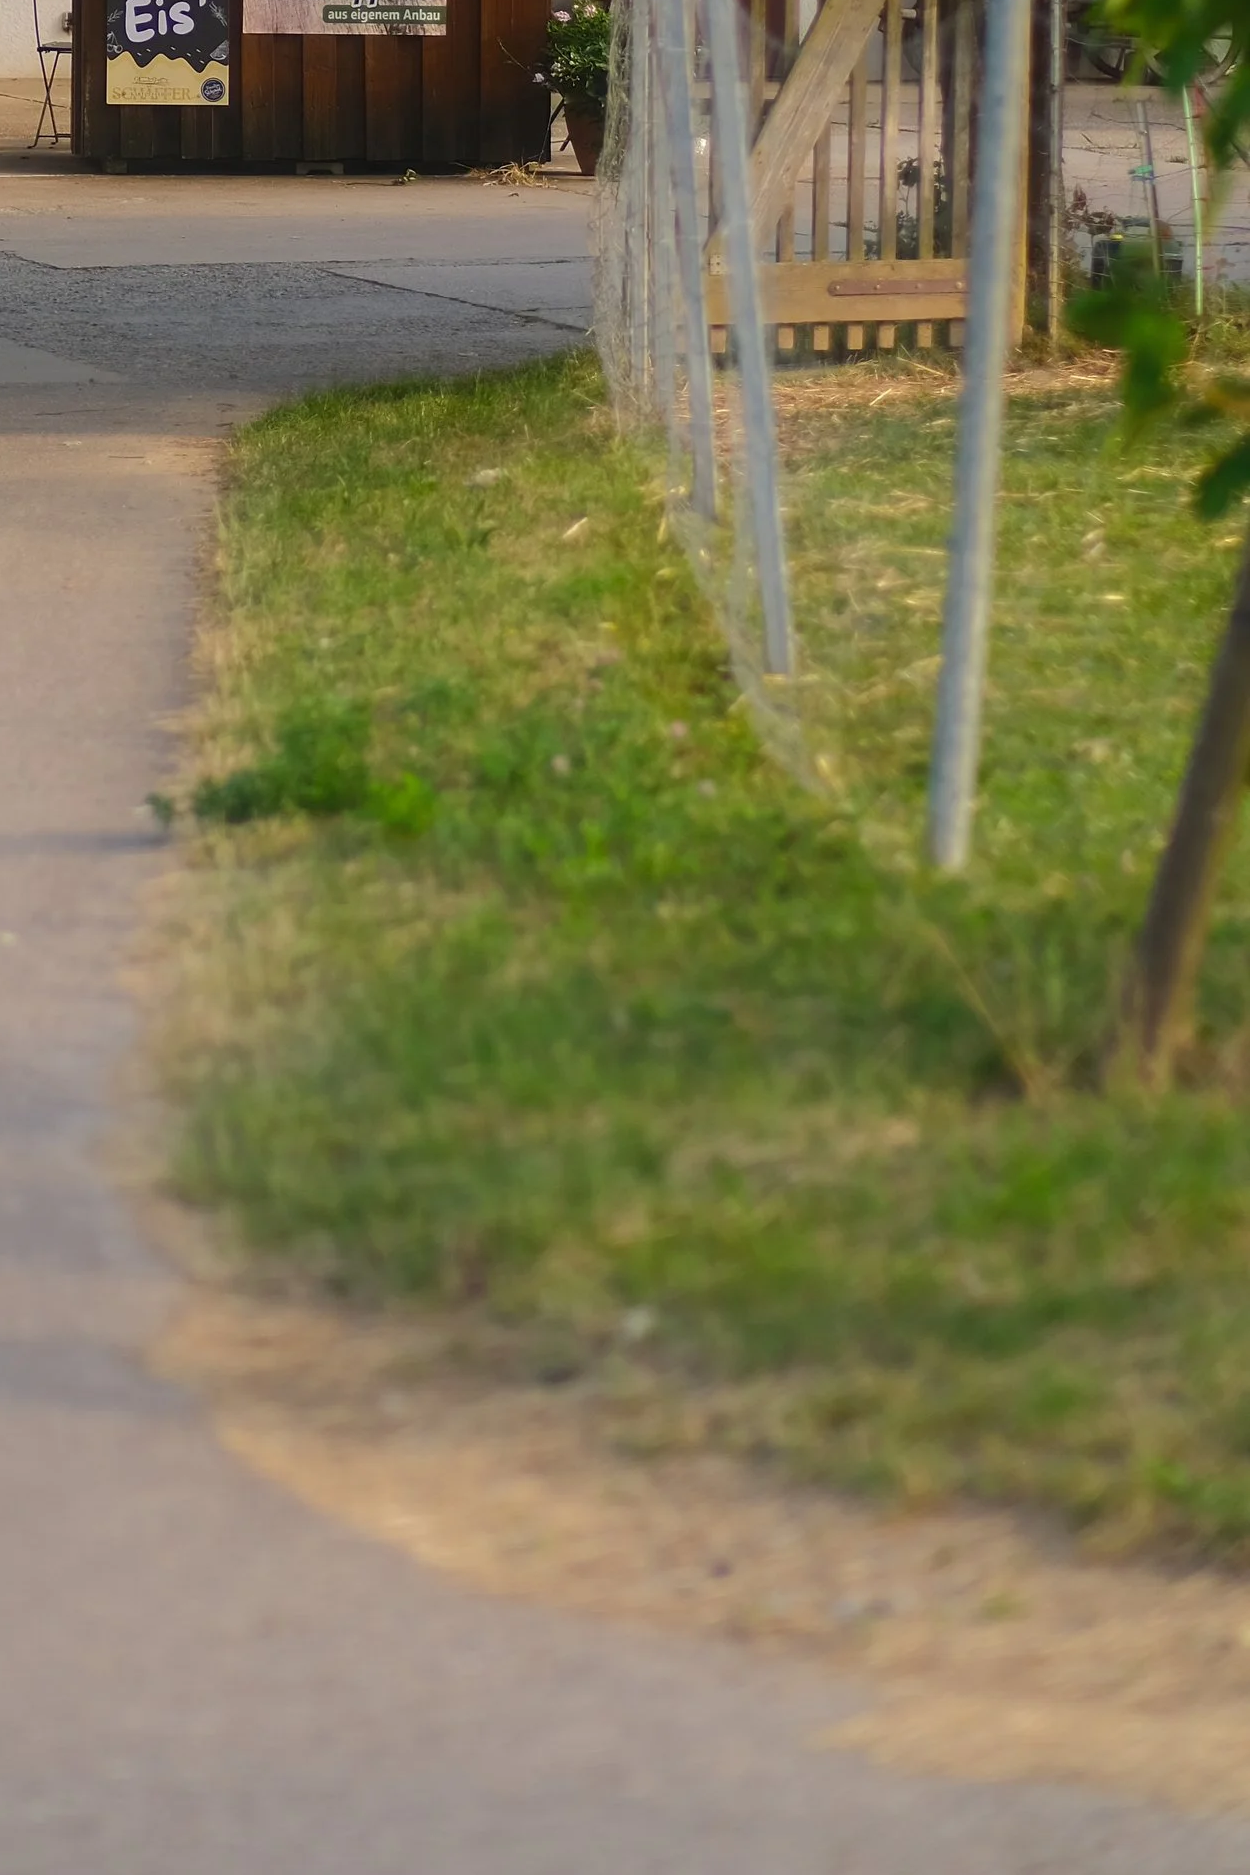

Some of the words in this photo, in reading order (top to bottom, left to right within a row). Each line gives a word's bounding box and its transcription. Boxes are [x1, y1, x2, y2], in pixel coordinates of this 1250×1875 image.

[327, 10, 348, 20] aus
[351, 9, 400, 23] eigenem
[403, 9, 441, 21] Anbau
